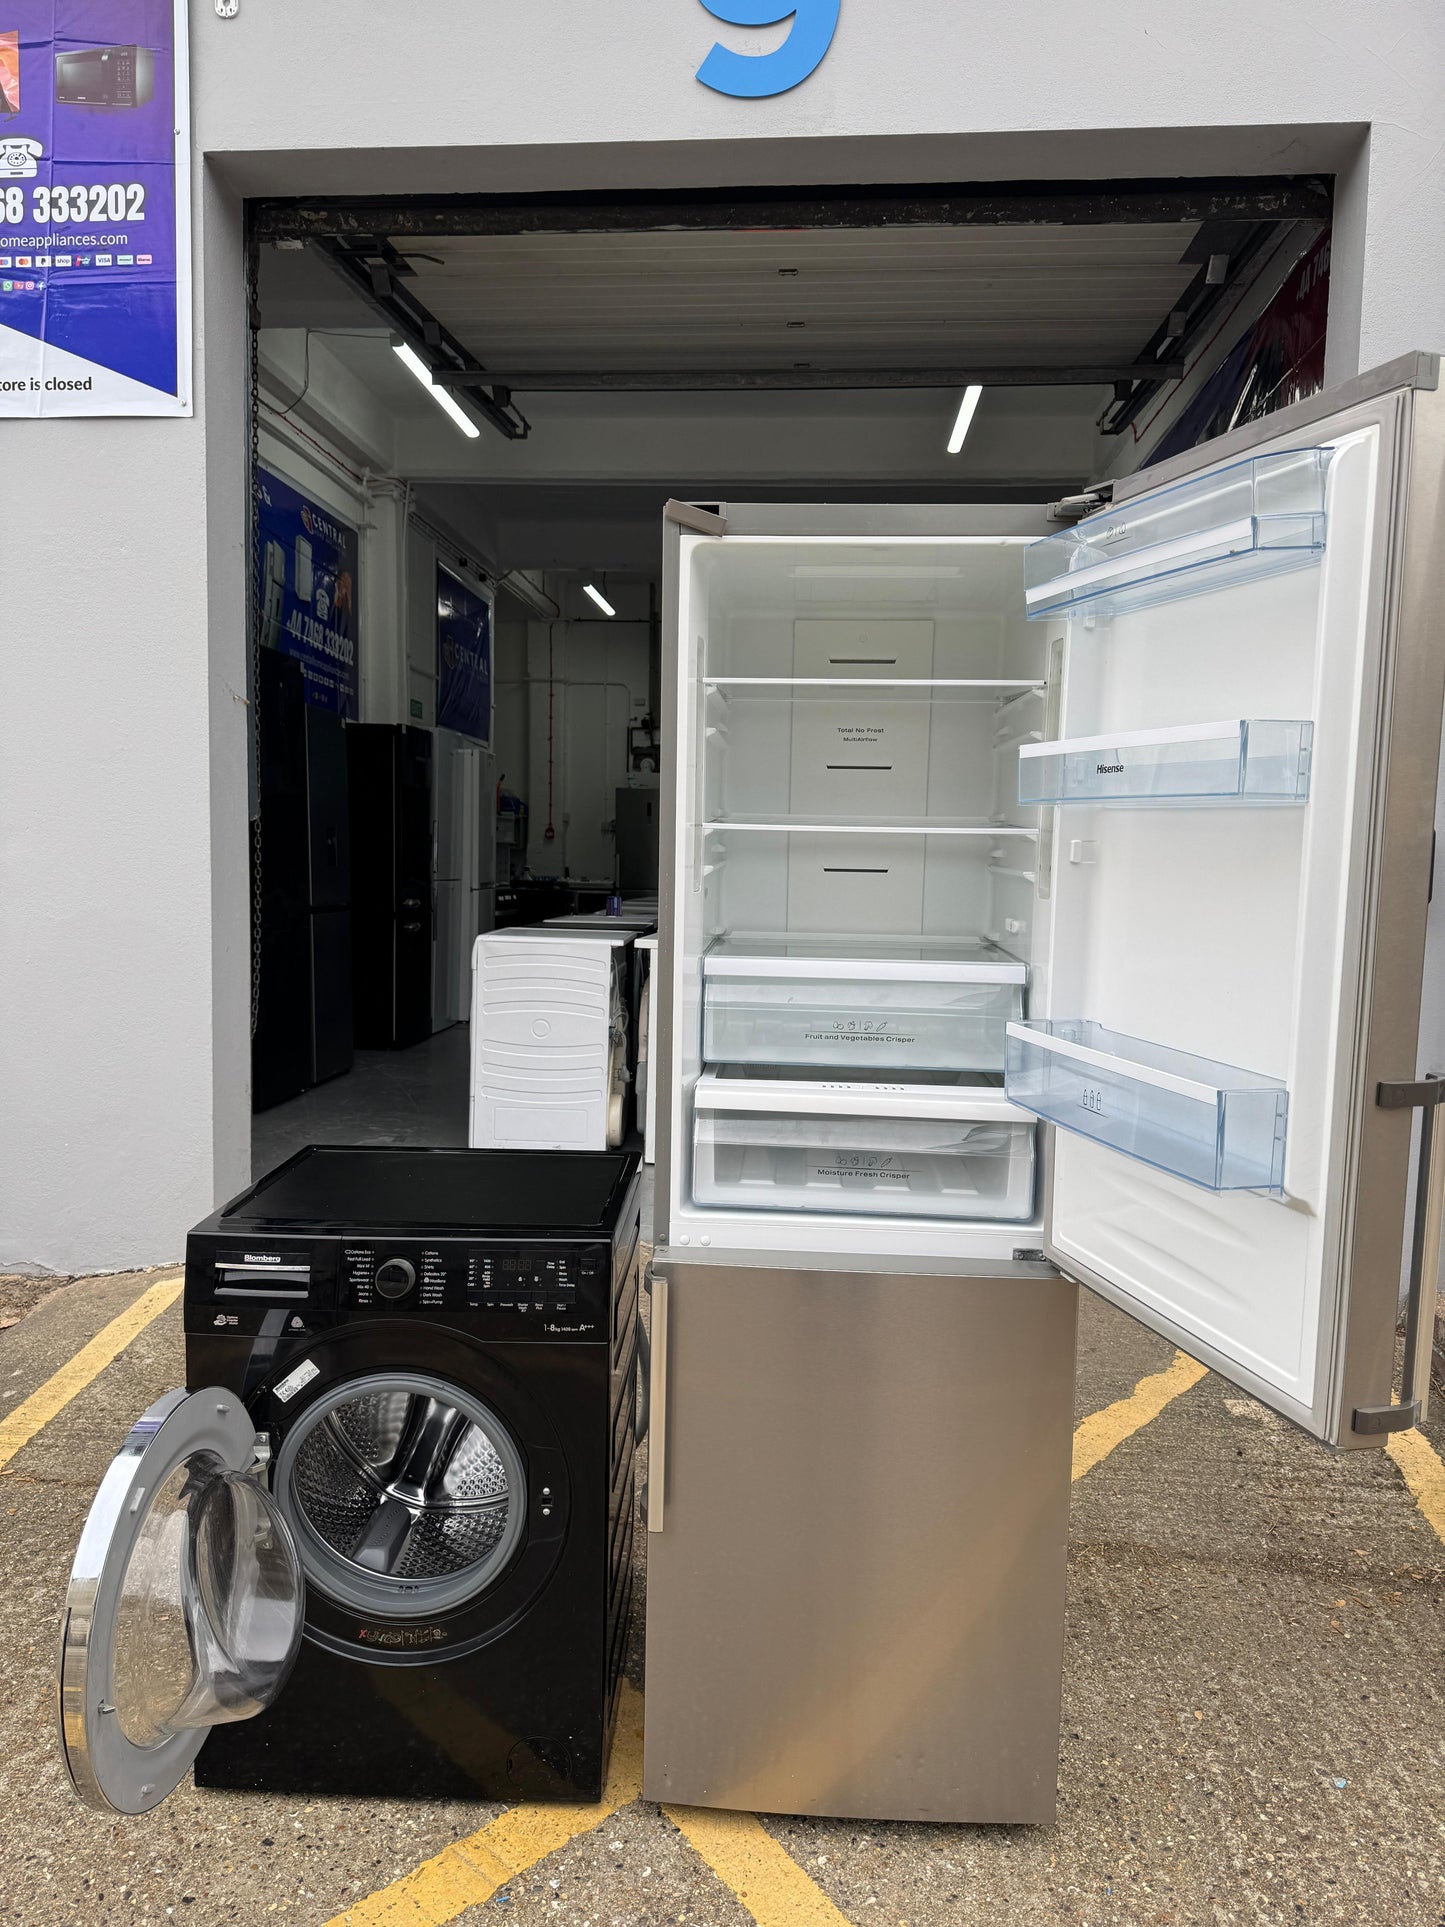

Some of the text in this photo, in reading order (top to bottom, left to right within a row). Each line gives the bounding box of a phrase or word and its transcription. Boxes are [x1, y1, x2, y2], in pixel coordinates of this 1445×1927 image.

[33, 183, 145, 223] 333202
[0, 233, 128, 249] omeappliances.com
[30, 377, 41, 391] is
[45, 376, 92, 391] closed
[312, 513, 346, 549] CENTRAL
[303, 615, 324, 651] 7468
[324, 627, 354, 667] 333202
[1096, 764, 1124, 774] Hisense
[840, 1034, 884, 1042] Vegetables
[817, 1169, 853, 1177] Moisture
[880, 1171, 910, 1179] Crisper
[244, 1254, 281, 1263] Blomberg
[579, 1323, 595, 1332] A+++
